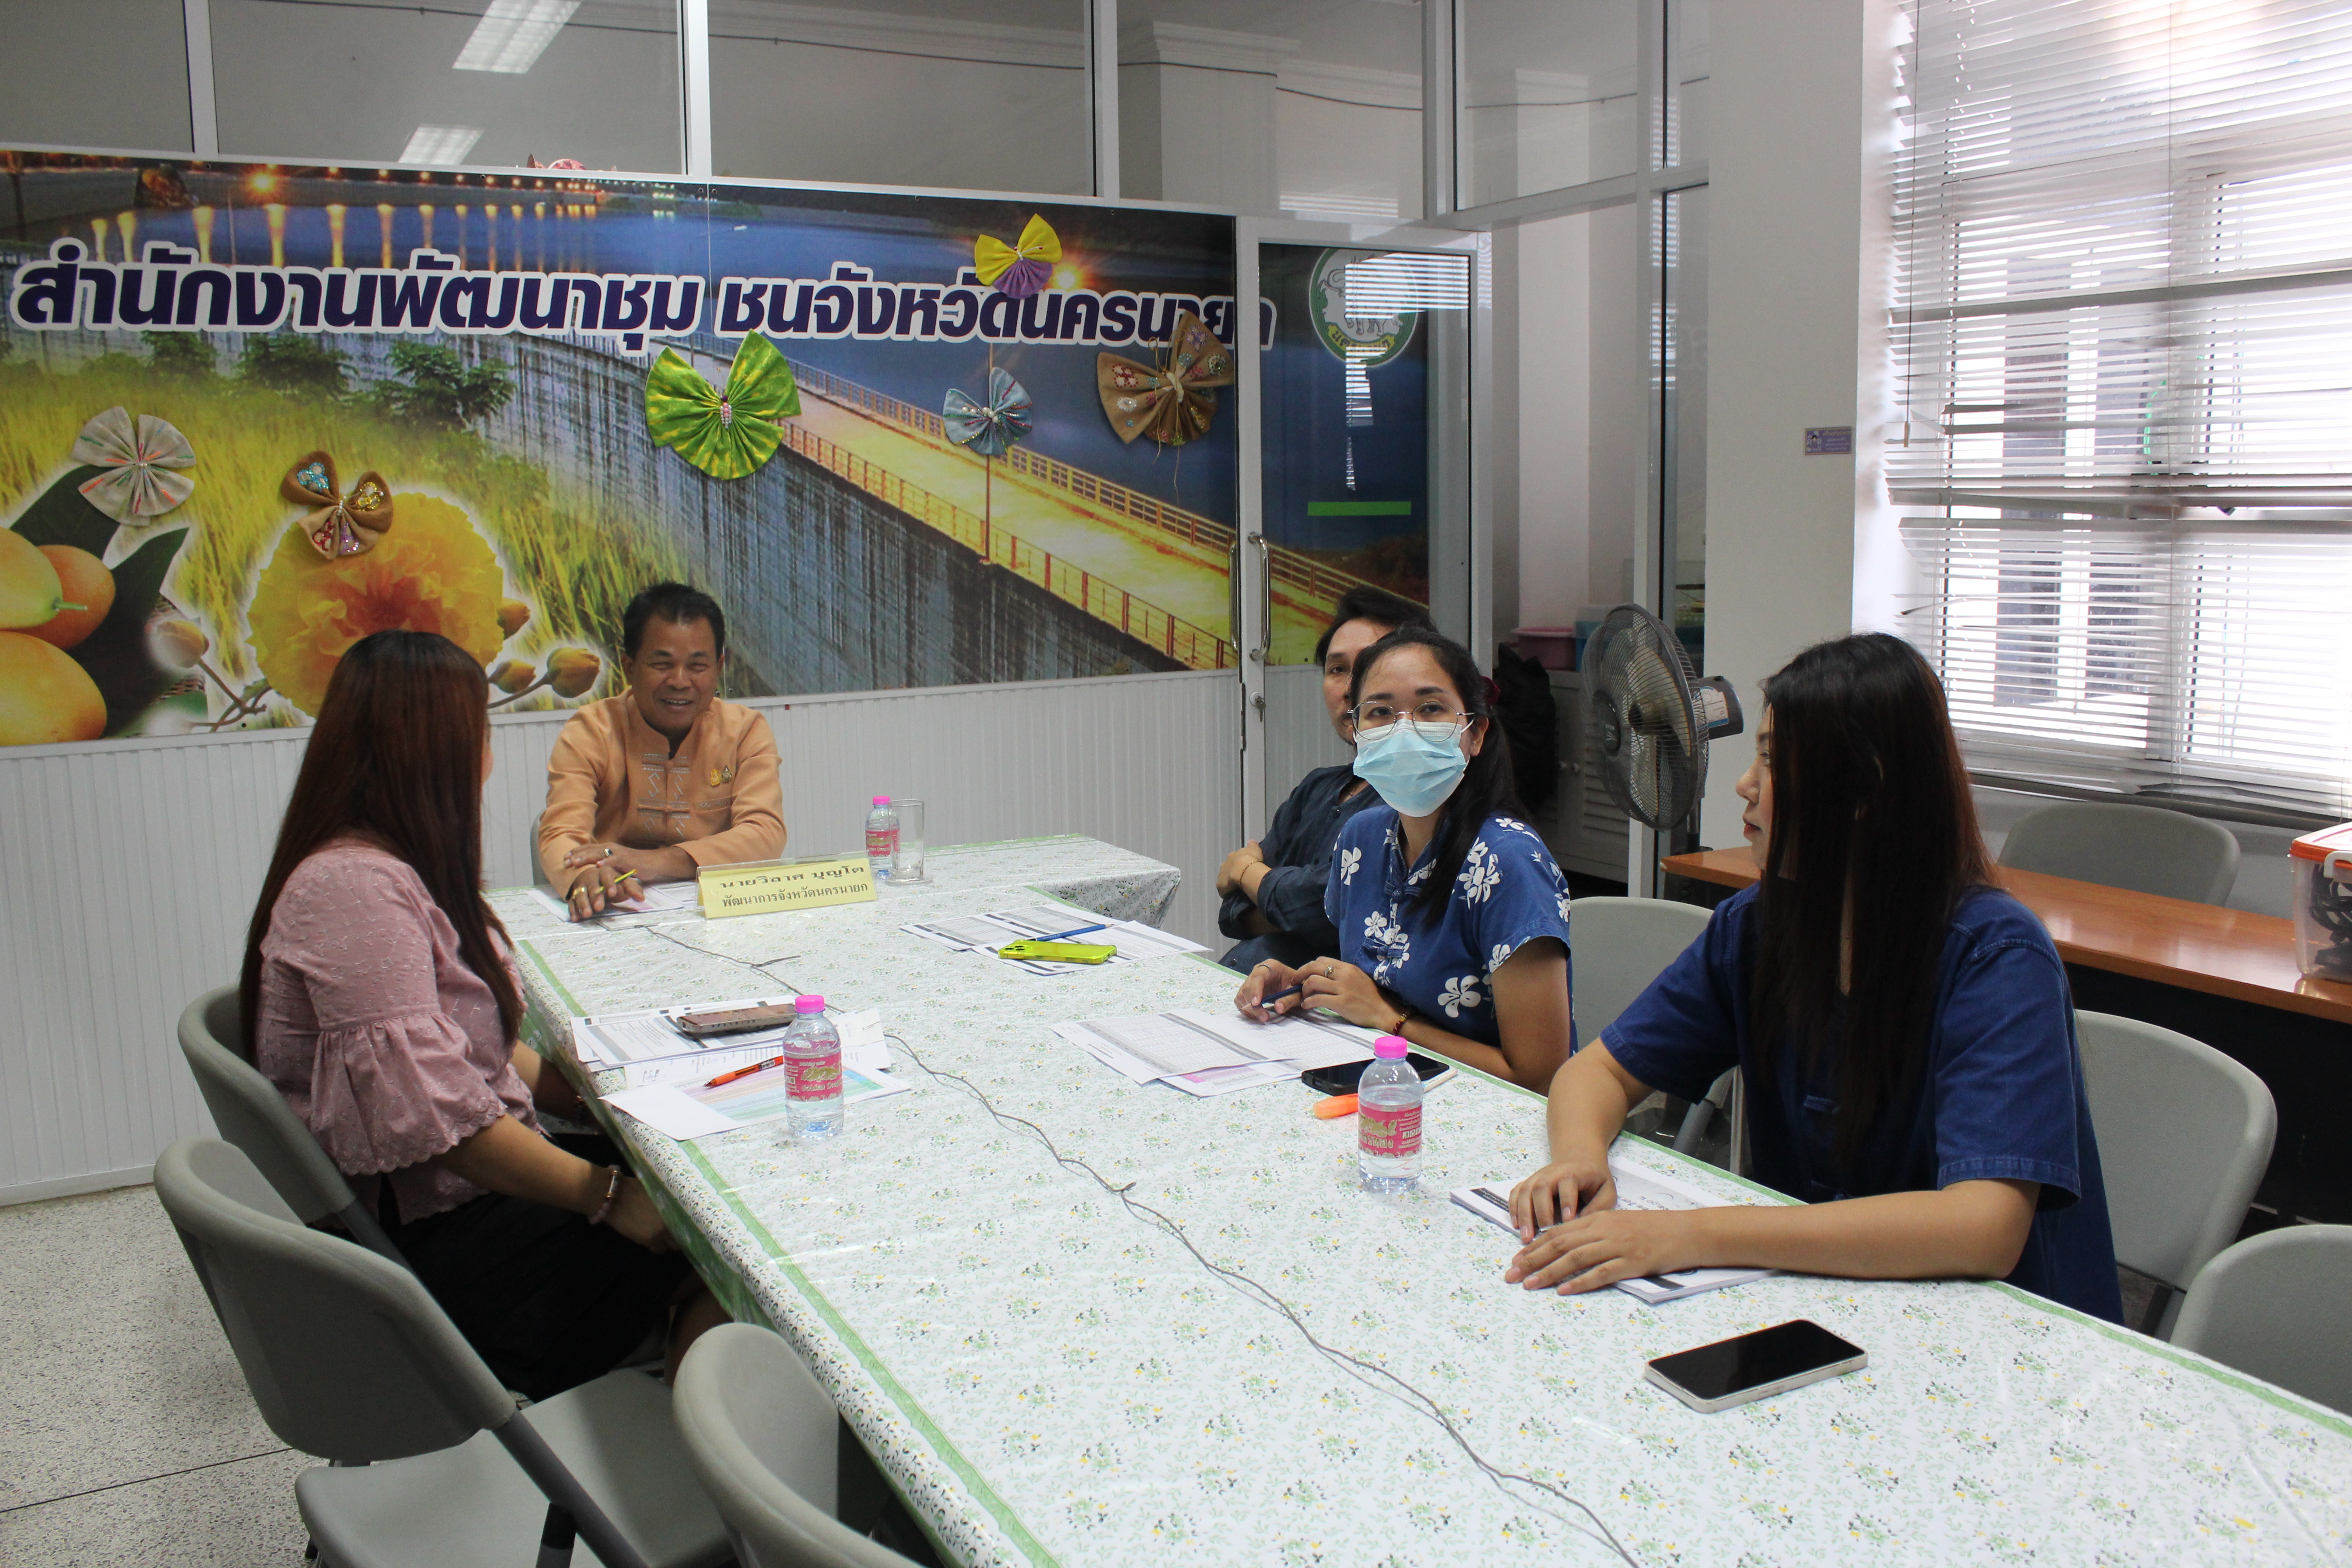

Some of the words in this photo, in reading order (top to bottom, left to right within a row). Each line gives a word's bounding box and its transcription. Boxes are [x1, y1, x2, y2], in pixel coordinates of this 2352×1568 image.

[16, 243, 700, 351] สำนักงานพัฒนาชุม
[811, 865, 864, 880] บุญโต
[722, 883, 868, 907] พัฒนาการจังหวัดนครนายก
